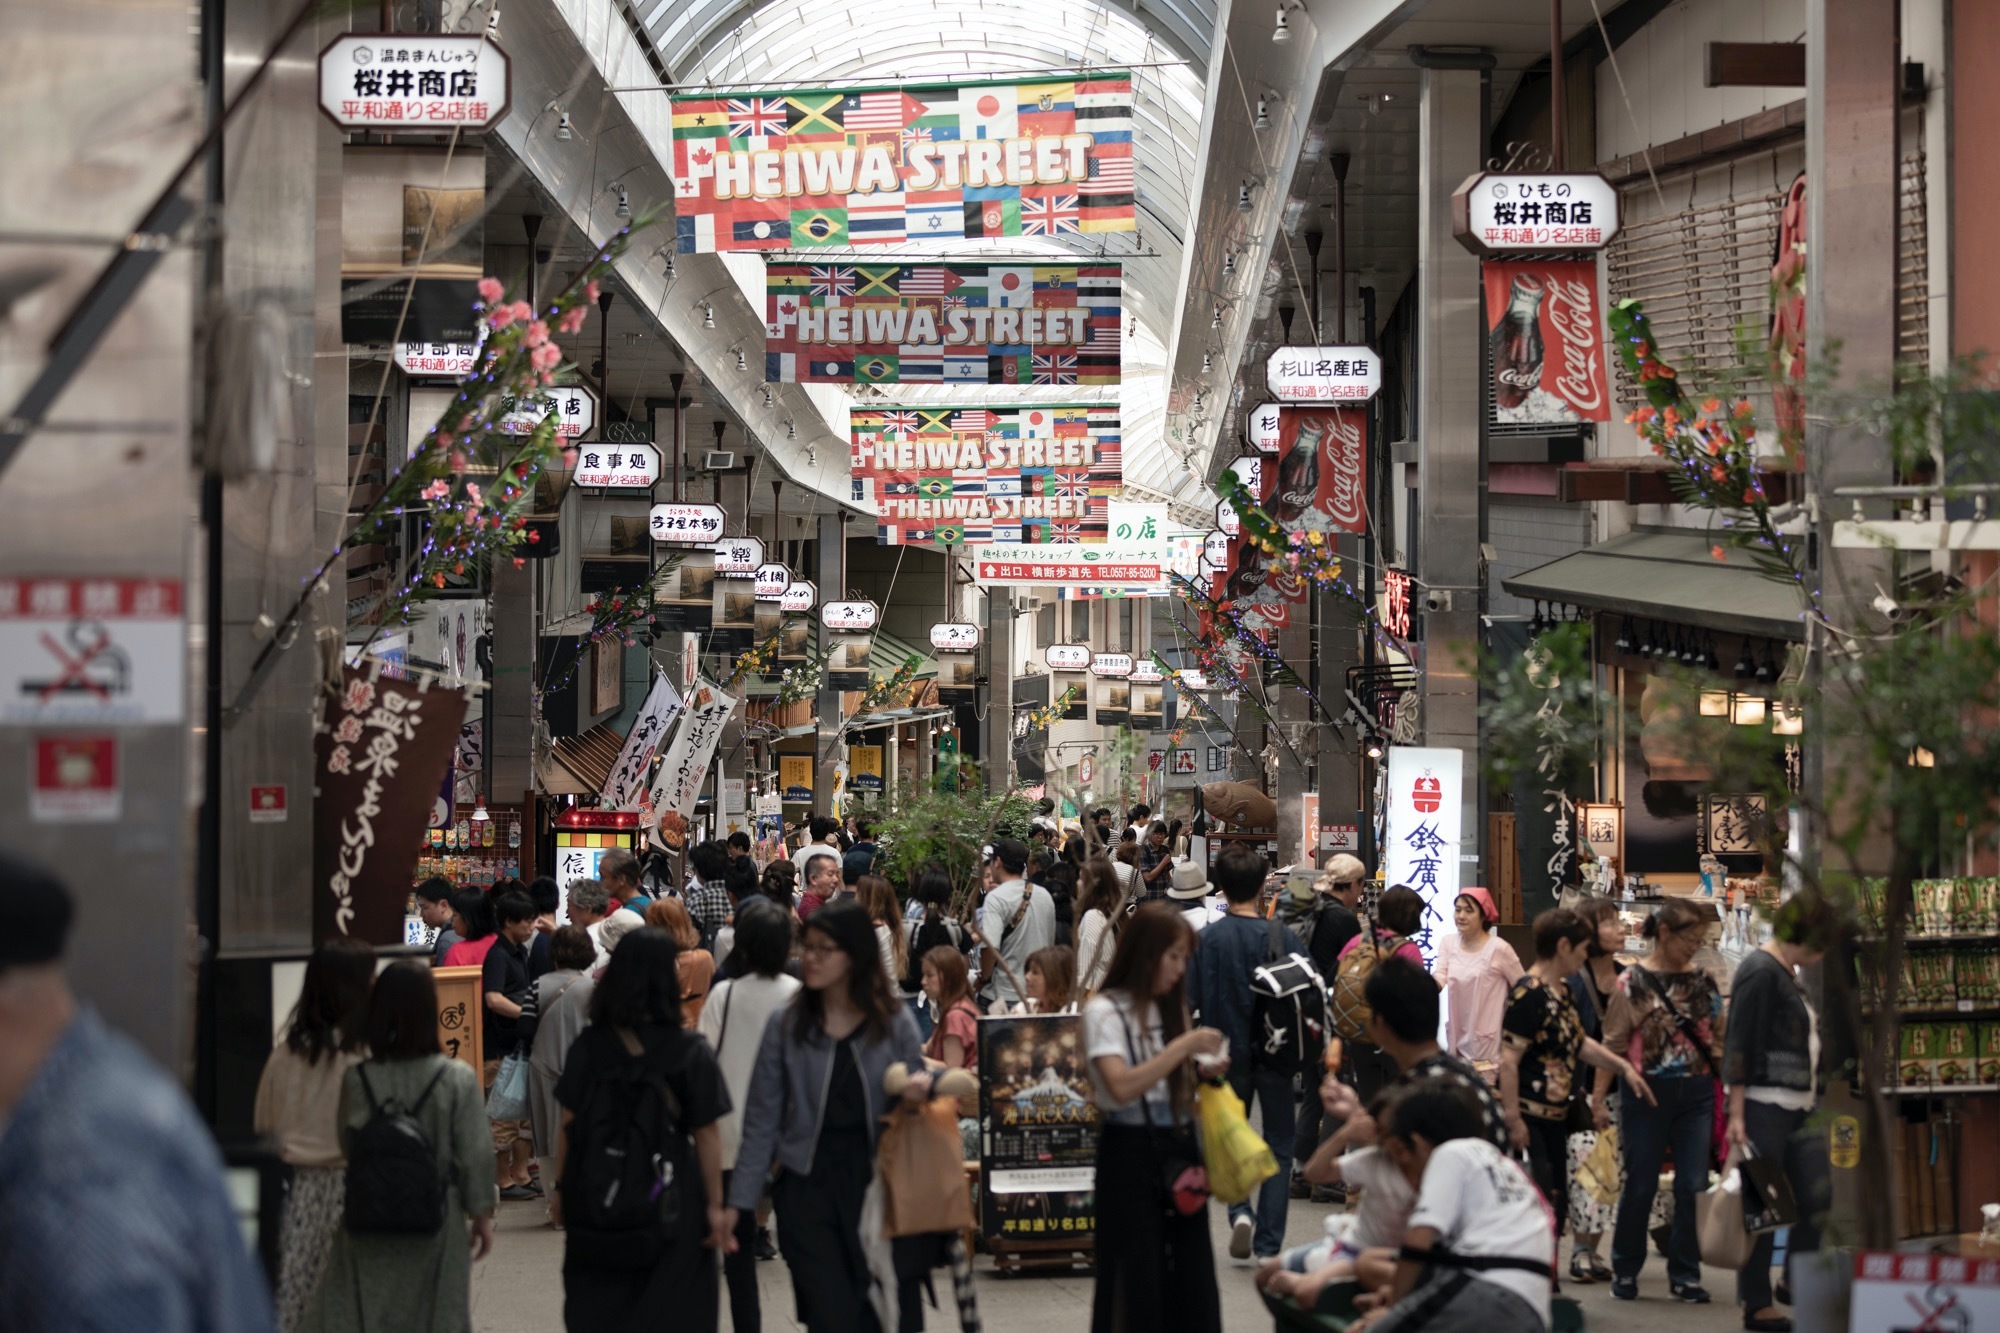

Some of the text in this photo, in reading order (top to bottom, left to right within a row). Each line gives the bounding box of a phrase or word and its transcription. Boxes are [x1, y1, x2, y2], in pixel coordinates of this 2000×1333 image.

[380, 48, 478, 63] 温泉まんじゅう
[353, 69, 478, 97] 桜井商店
[341, 101, 489, 121] 平和通り名店街
[713, 132, 1093, 199] HEIWA STREET
[1518, 183, 1572, 198] ひもの
[1493, 201, 1593, 226] 桜井商店
[1484, 228, 1602, 244] 平和通り名店街
[797, 306, 1091, 345] HEIWA STREET
[1280, 360, 1368, 376] 杉山名産店
[1278, 385, 1369, 398] 平和通り名店街
[1261, 416, 1280, 431] 杉
[584, 453, 646, 469] 食事処
[873, 437, 1098, 470] HEIWA STREET
[579, 474, 650, 485] 平和通り名店街
[669, 507, 703, 515] おかき処
[897, 496, 1088, 519] HEIWA STREET
[651, 515, 720, 532] 寺子屋本舗
[1116, 515, 1157, 541] の店
[656, 532, 714, 541] 平和通り名店街
[982, 548, 1073, 560] 趣味のギフトショップ
[1105, 550, 1158, 561] ヴィーナス
[715, 563, 754, 571] 通り名店街
[1000, 565, 1157, 579] 出口、横断歩道先 TEL.0557-85-5200
